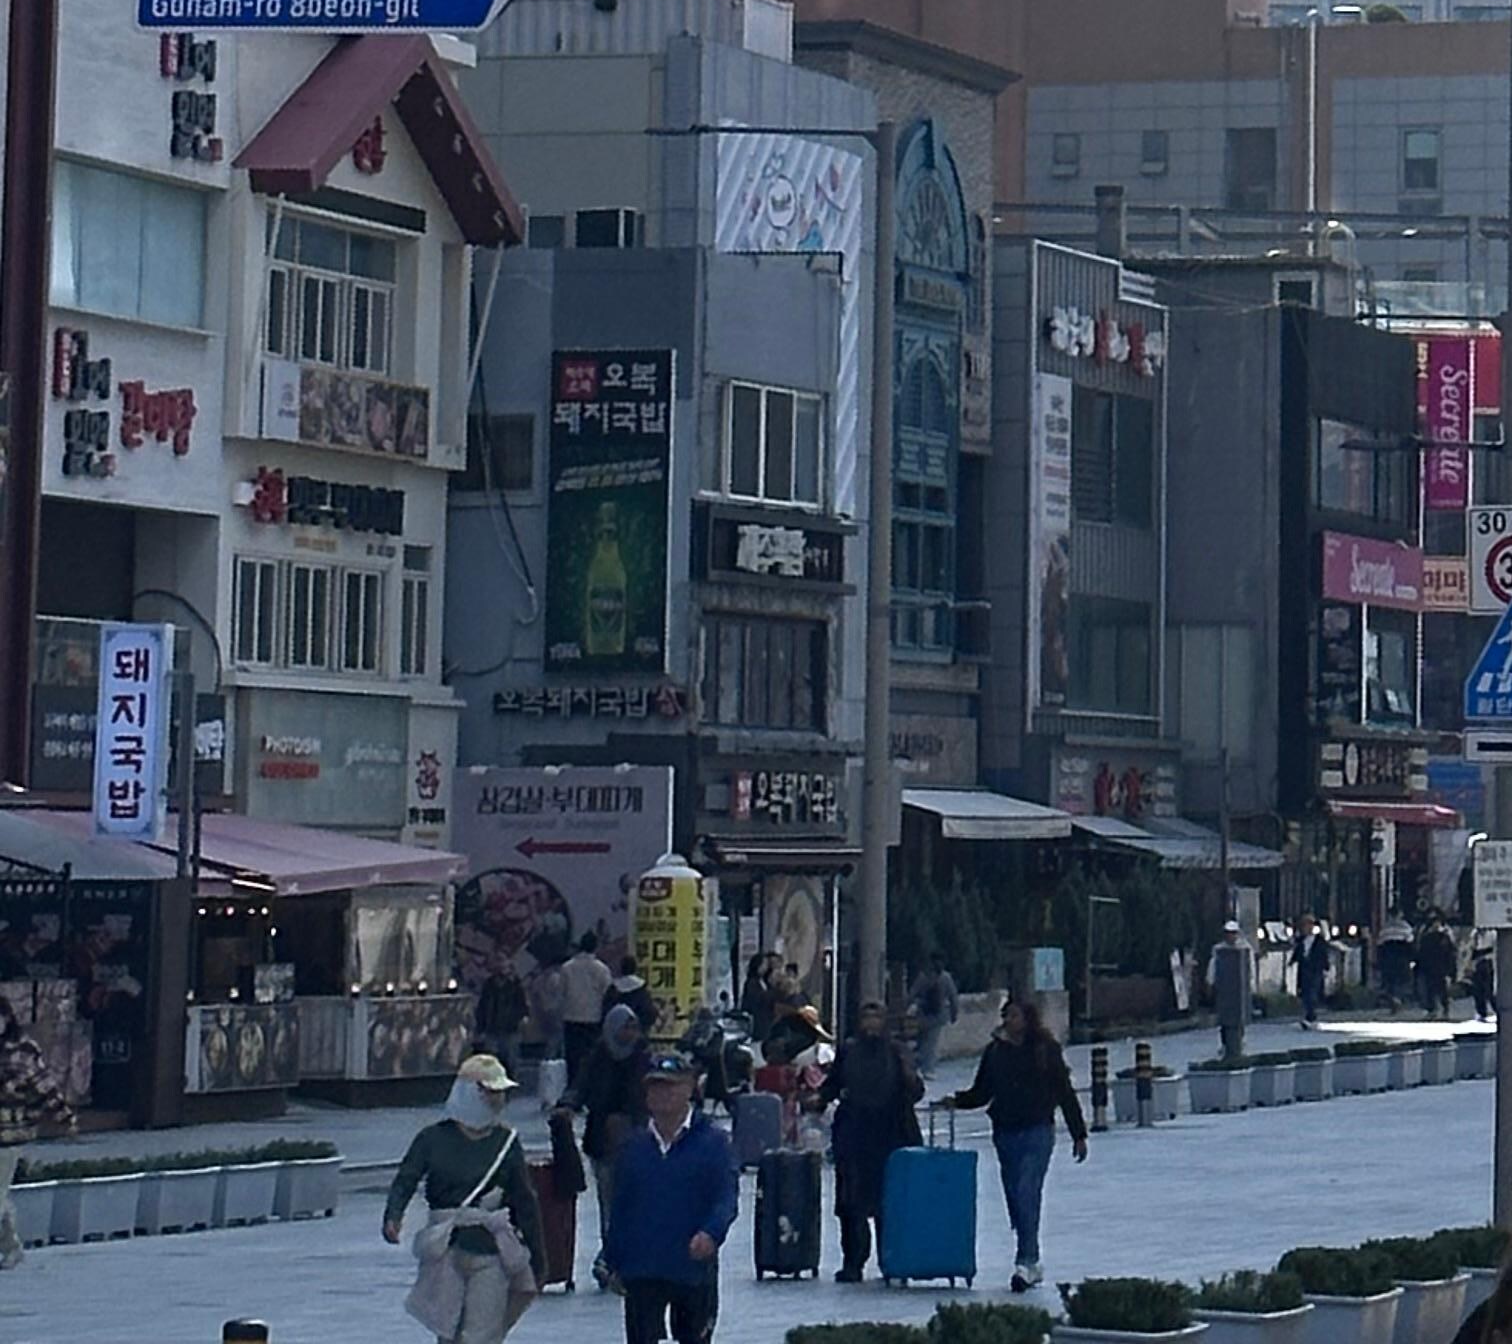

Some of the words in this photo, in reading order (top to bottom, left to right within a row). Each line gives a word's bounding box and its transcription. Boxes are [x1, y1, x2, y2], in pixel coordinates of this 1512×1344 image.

[602, 362, 658, 397] 오복
[553, 401, 668, 435] 돼지국밥
[1477, 511, 1507, 535] 30
[496, 685, 650, 718] 오복돼지국밥
[107, 647, 151, 819] 돼지국밥
